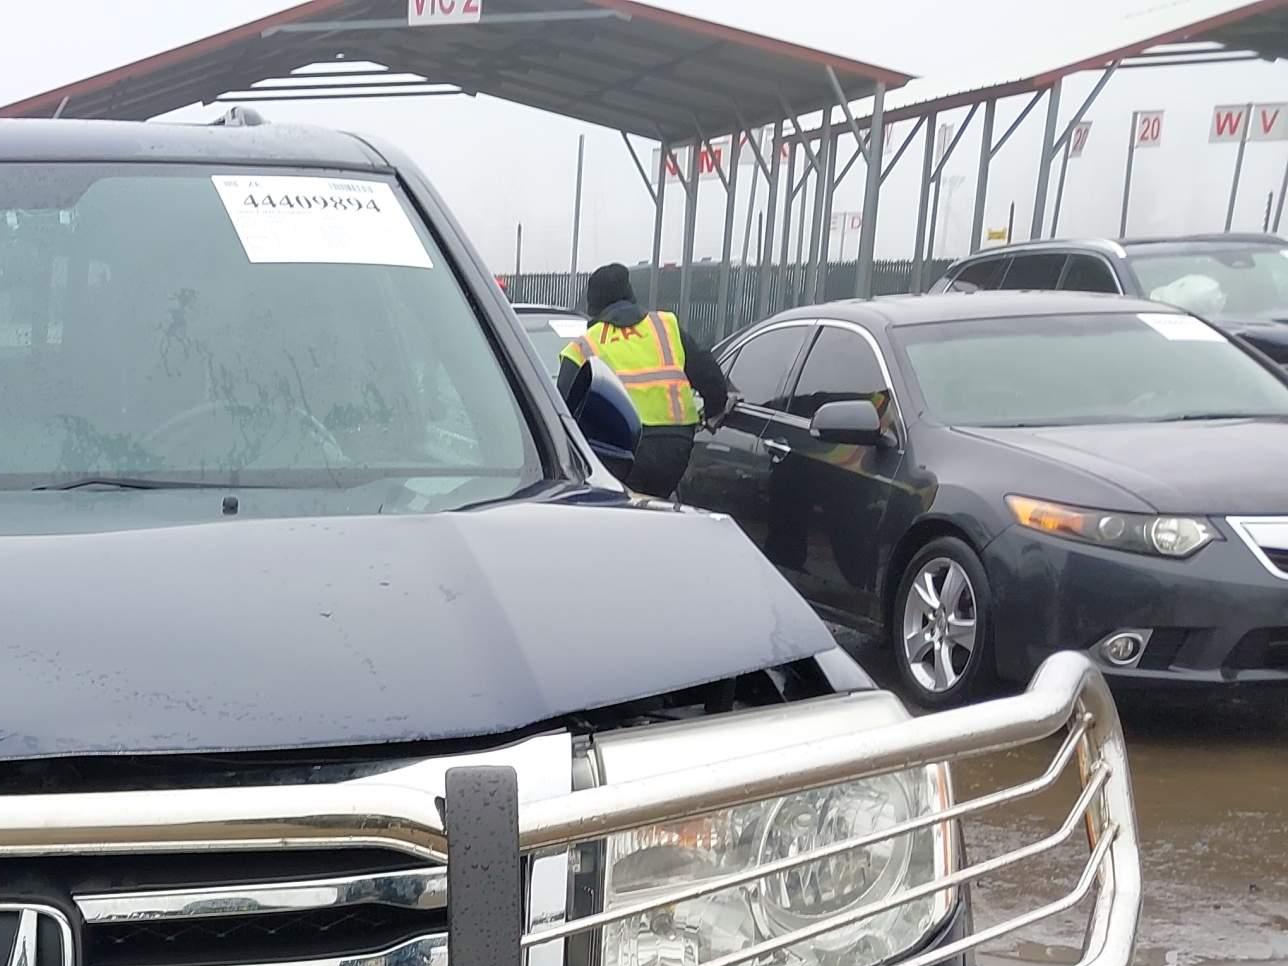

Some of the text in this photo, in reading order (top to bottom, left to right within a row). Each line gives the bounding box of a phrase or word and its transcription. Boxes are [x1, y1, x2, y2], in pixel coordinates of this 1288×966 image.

[1139, 116, 1161, 142] 20
[1215, 110, 1243, 136] W
[1260, 108, 1280, 134] V
[243, 193, 382, 213] 44409894
